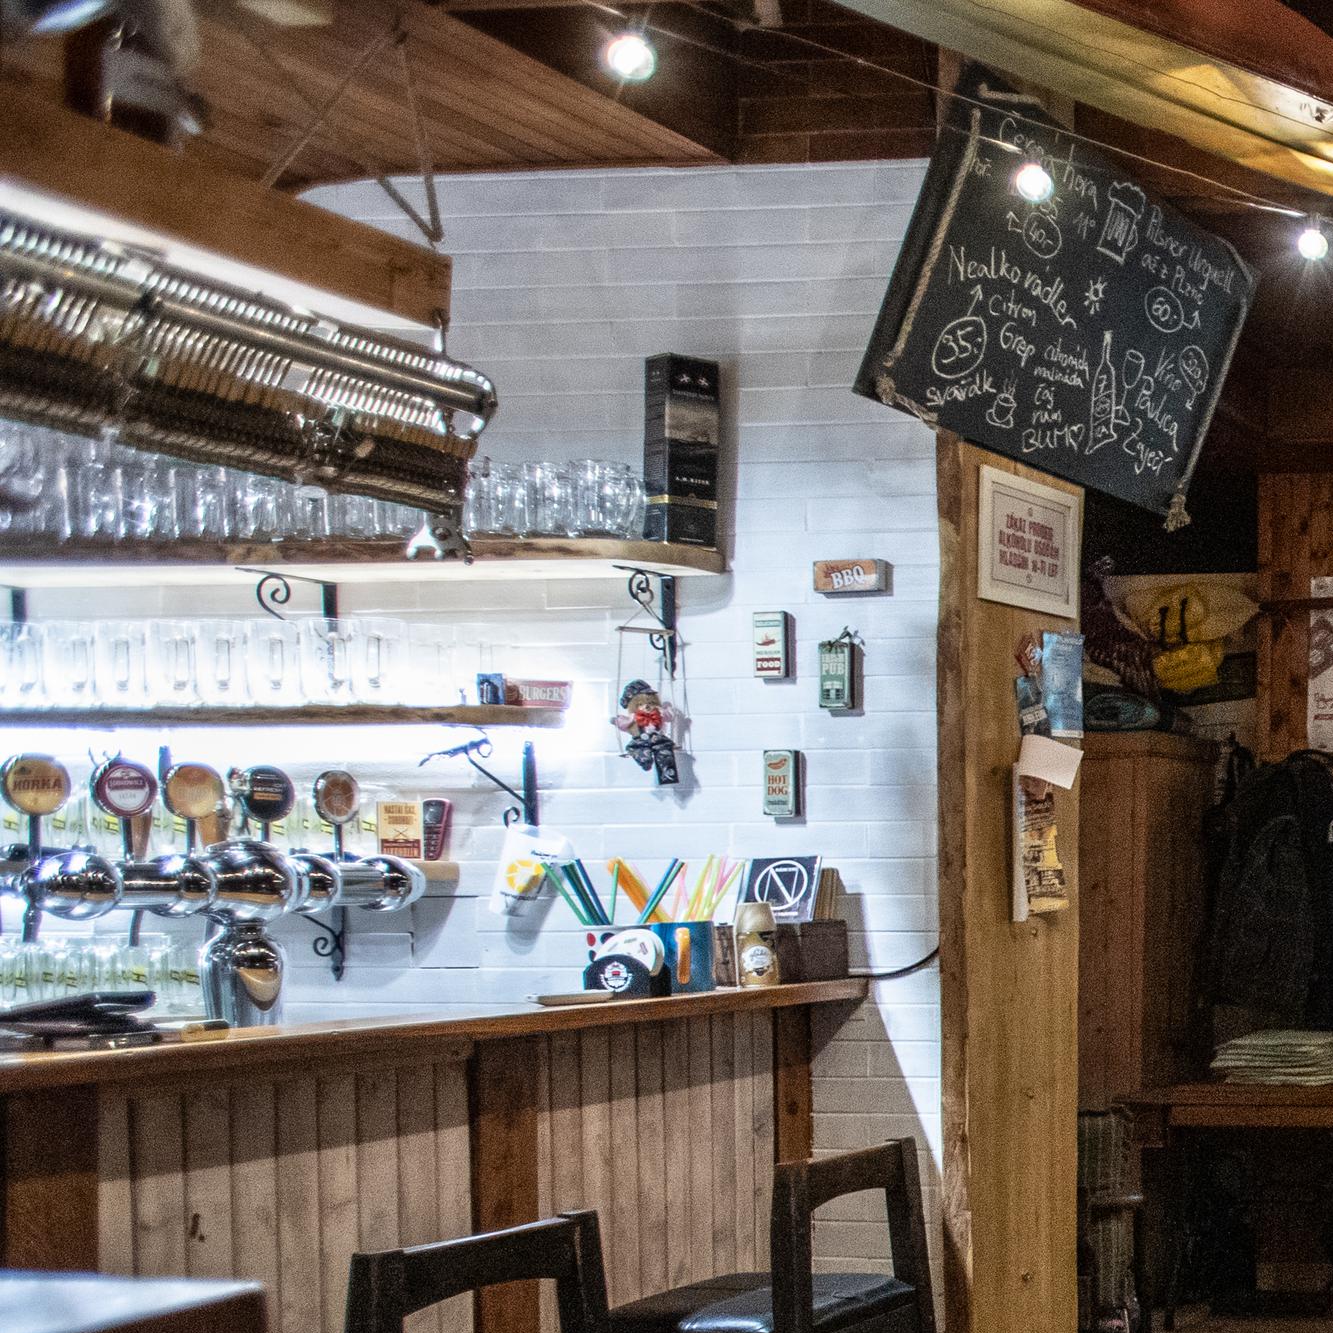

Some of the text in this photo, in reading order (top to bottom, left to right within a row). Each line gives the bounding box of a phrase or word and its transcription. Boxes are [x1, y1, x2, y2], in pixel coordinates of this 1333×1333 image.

[947, 245, 1022, 285] Nealko
[999, 321, 1037, 369] Grep
[831, 564, 866, 590] BBQ
[756, 660, 781, 669] FOOD
[821, 663, 846, 676] PUB
[767, 774, 788, 785] HOT
[767, 786, 789, 796] DOG
